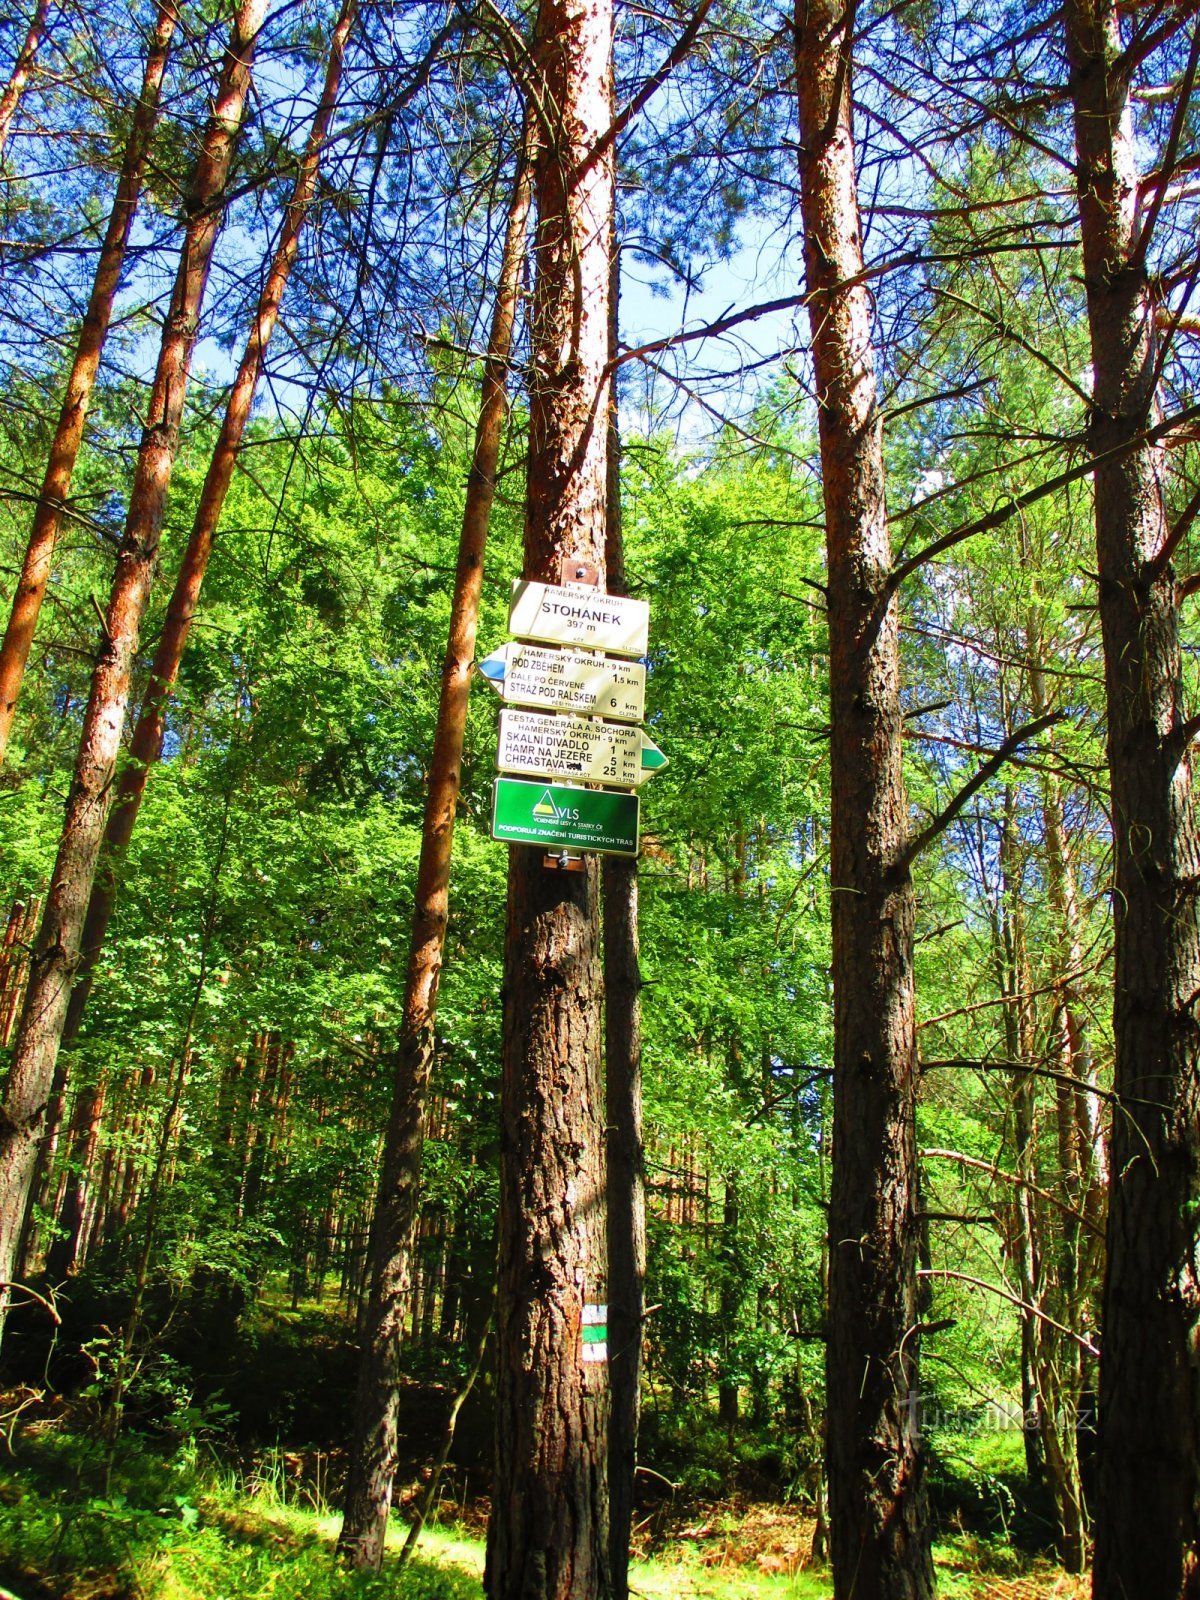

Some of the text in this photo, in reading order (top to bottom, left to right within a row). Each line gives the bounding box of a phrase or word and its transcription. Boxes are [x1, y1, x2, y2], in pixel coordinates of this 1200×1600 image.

[593, 597, 623, 606] OKRUH
[542, 602, 621, 625] STOHÁNEK
[567, 619, 583, 628] 397
[512, 657, 528, 668] POD
[524, 649, 572, 663] HAMERSKÝ
[574, 658, 604, 668] OKRUH
[535, 676, 545, 684] PO
[548, 676, 585, 690] ČERVENÉ
[510, 682, 637, 711] STRÁŽ POD RALSKEM 6 km
[508, 714, 535, 724] CESTA
[538, 717, 582, 730] GENERÁLA
[595, 726, 636, 738] SOCHORA
[518, 724, 566, 736] HAMERSKÝ
[570, 731, 600, 741] OKRUH
[507, 732, 543, 744] SKALNÍ
[546, 736, 589, 750] DIVADLO
[611, 746, 615, 754] 1
[506, 743, 534, 754] HAMR
[538, 748, 552, 757] NA
[554, 750, 592, 762] JEZEŘE
[611, 757, 616, 766] 5
[505, 754, 564, 769] CHRASTAVA
[604, 766, 616, 776] 25
[558, 807, 579, 820] VLS
[498, 824, 536, 834] PODPORUJÍ
[538, 829, 566, 838] ZNAČENÍ
[568, 833, 614, 844] TURISTICKÝCH
